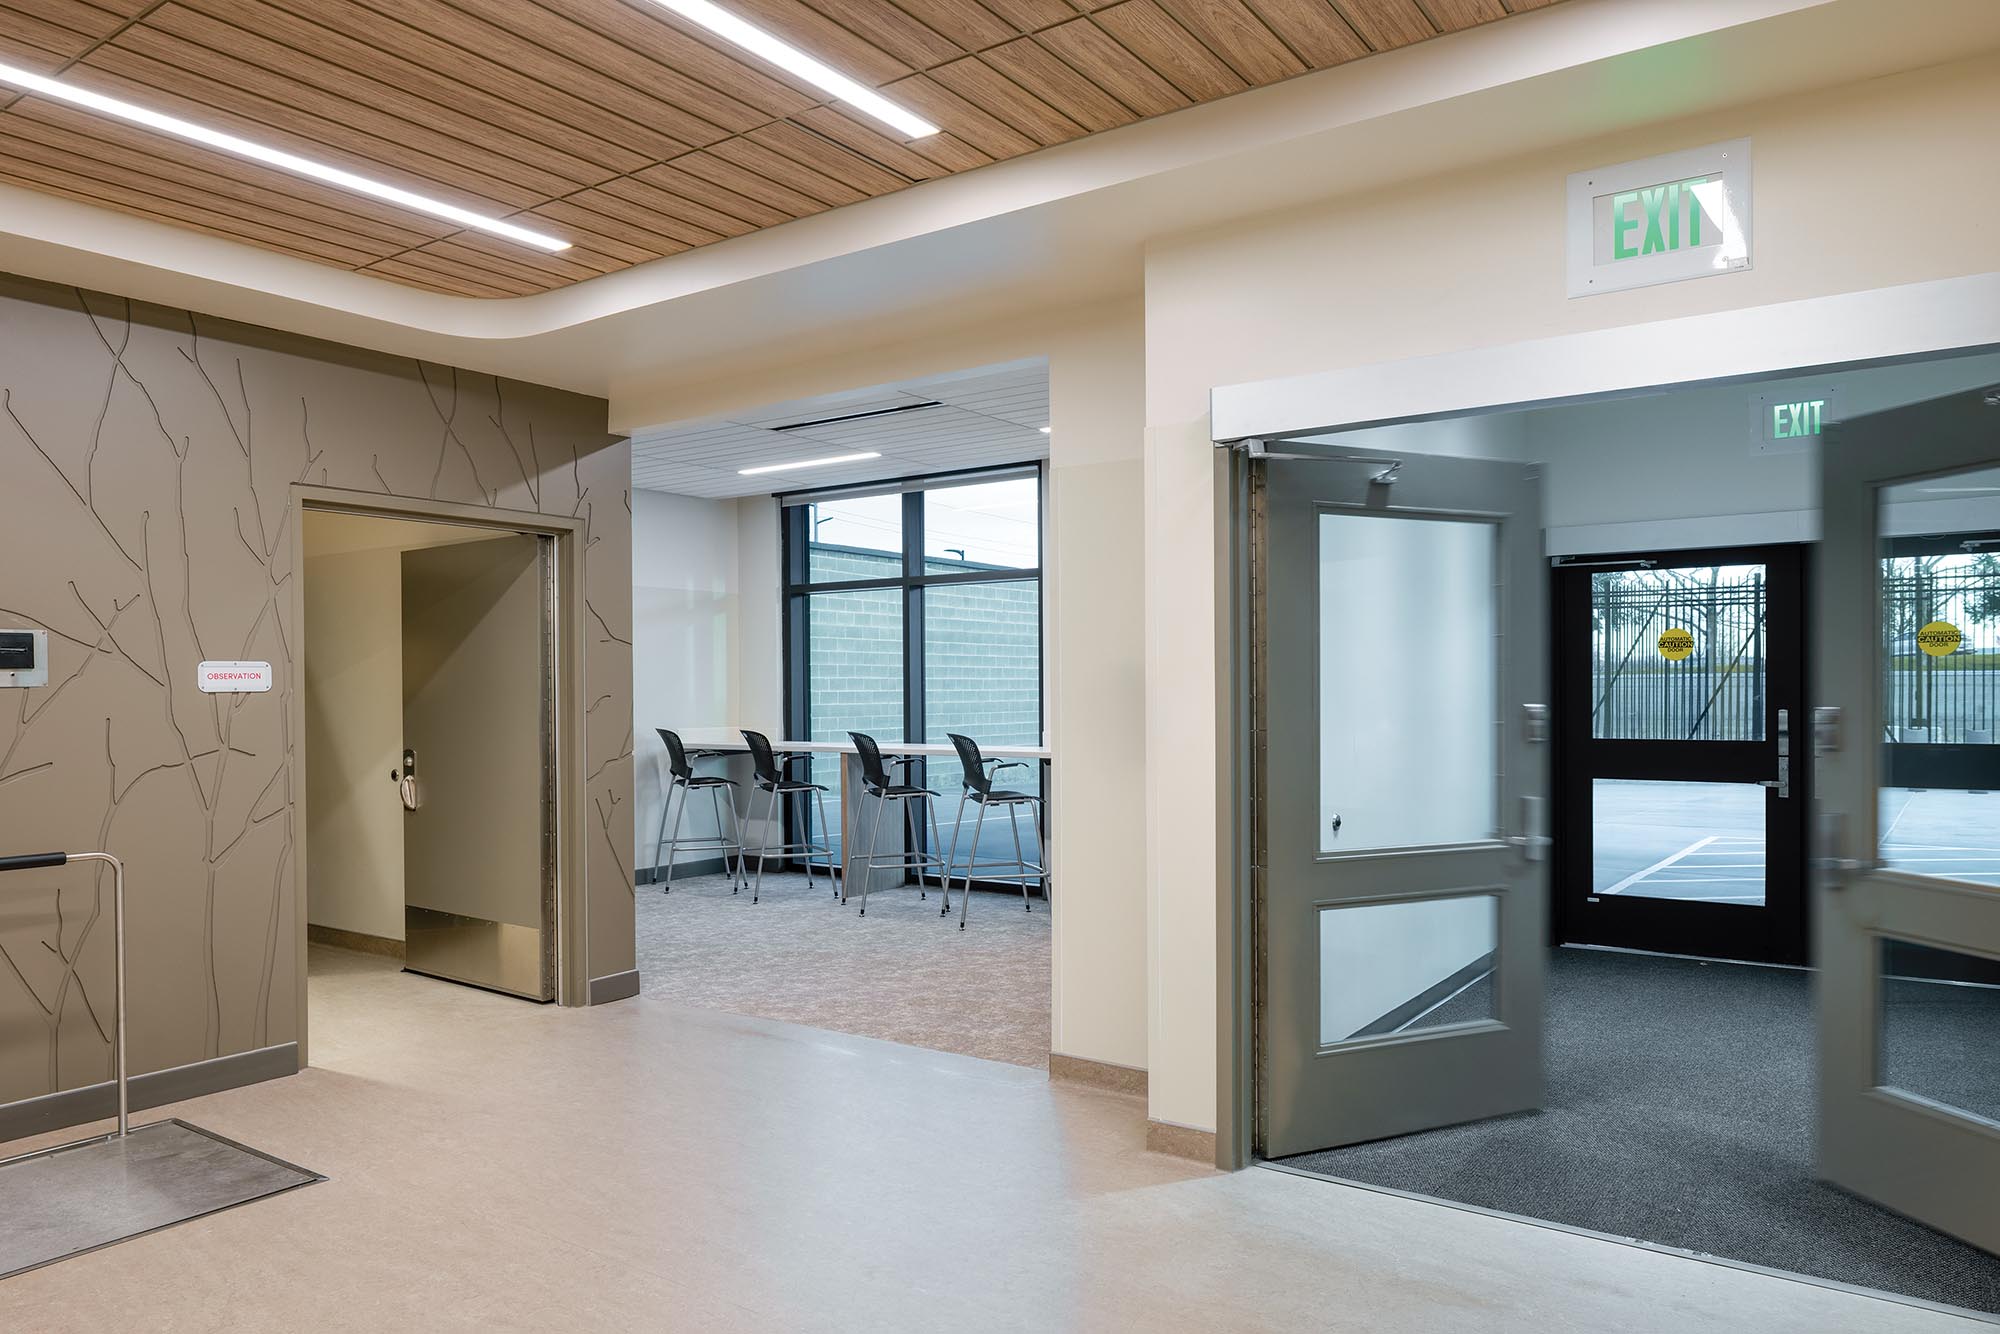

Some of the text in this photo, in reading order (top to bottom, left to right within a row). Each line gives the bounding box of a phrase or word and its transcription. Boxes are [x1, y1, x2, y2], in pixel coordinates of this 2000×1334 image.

[1613, 178, 1708, 260] EXIT
[1774, 400, 1824, 439] EXIT
[206, 672, 262, 680] OBSERVATION
